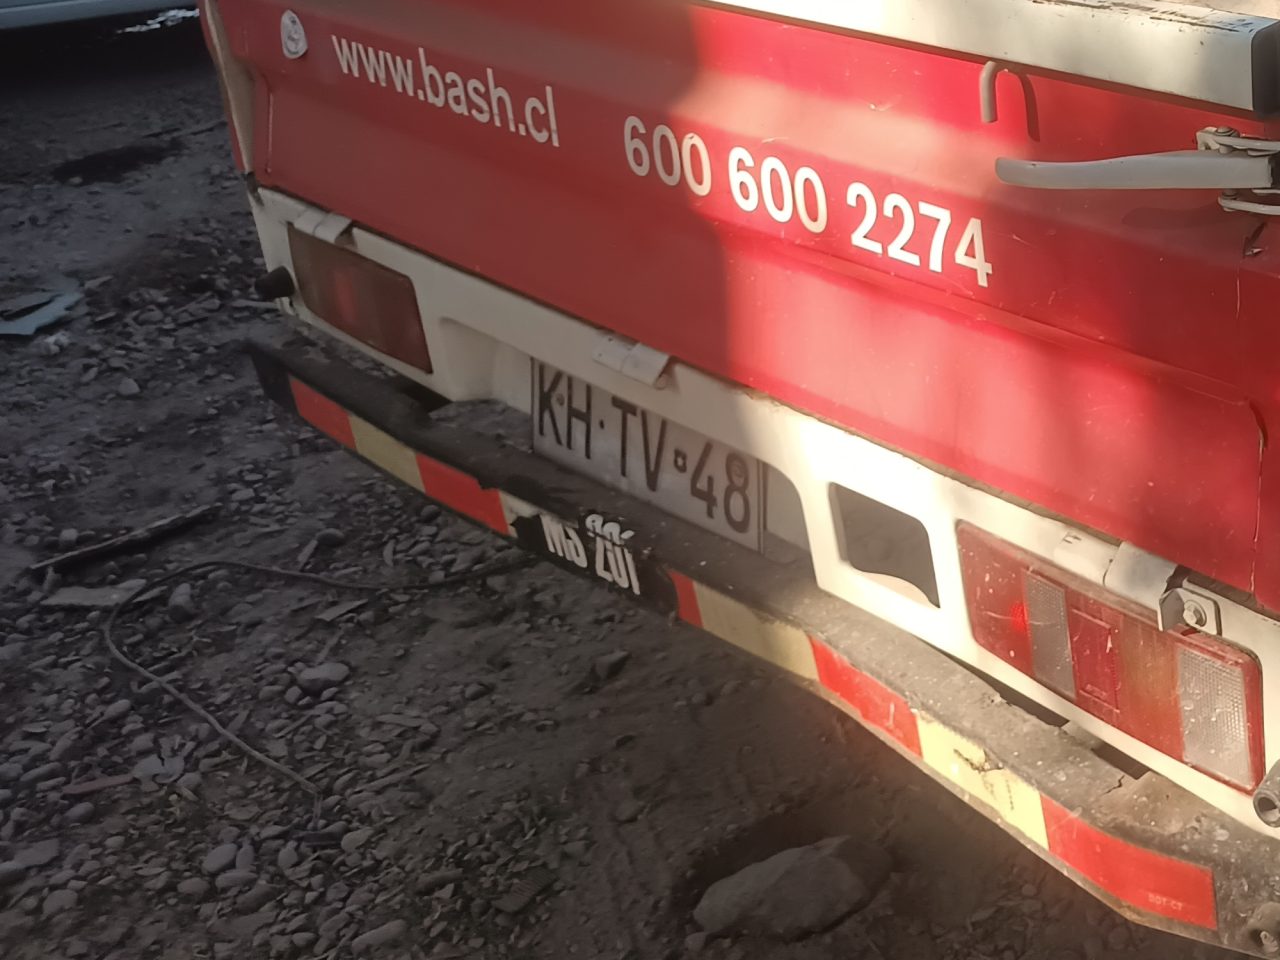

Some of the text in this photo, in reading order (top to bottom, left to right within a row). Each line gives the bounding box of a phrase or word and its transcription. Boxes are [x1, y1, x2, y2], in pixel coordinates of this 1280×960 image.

[331, 34, 993, 288] www.bash.cl 600 600 2274
